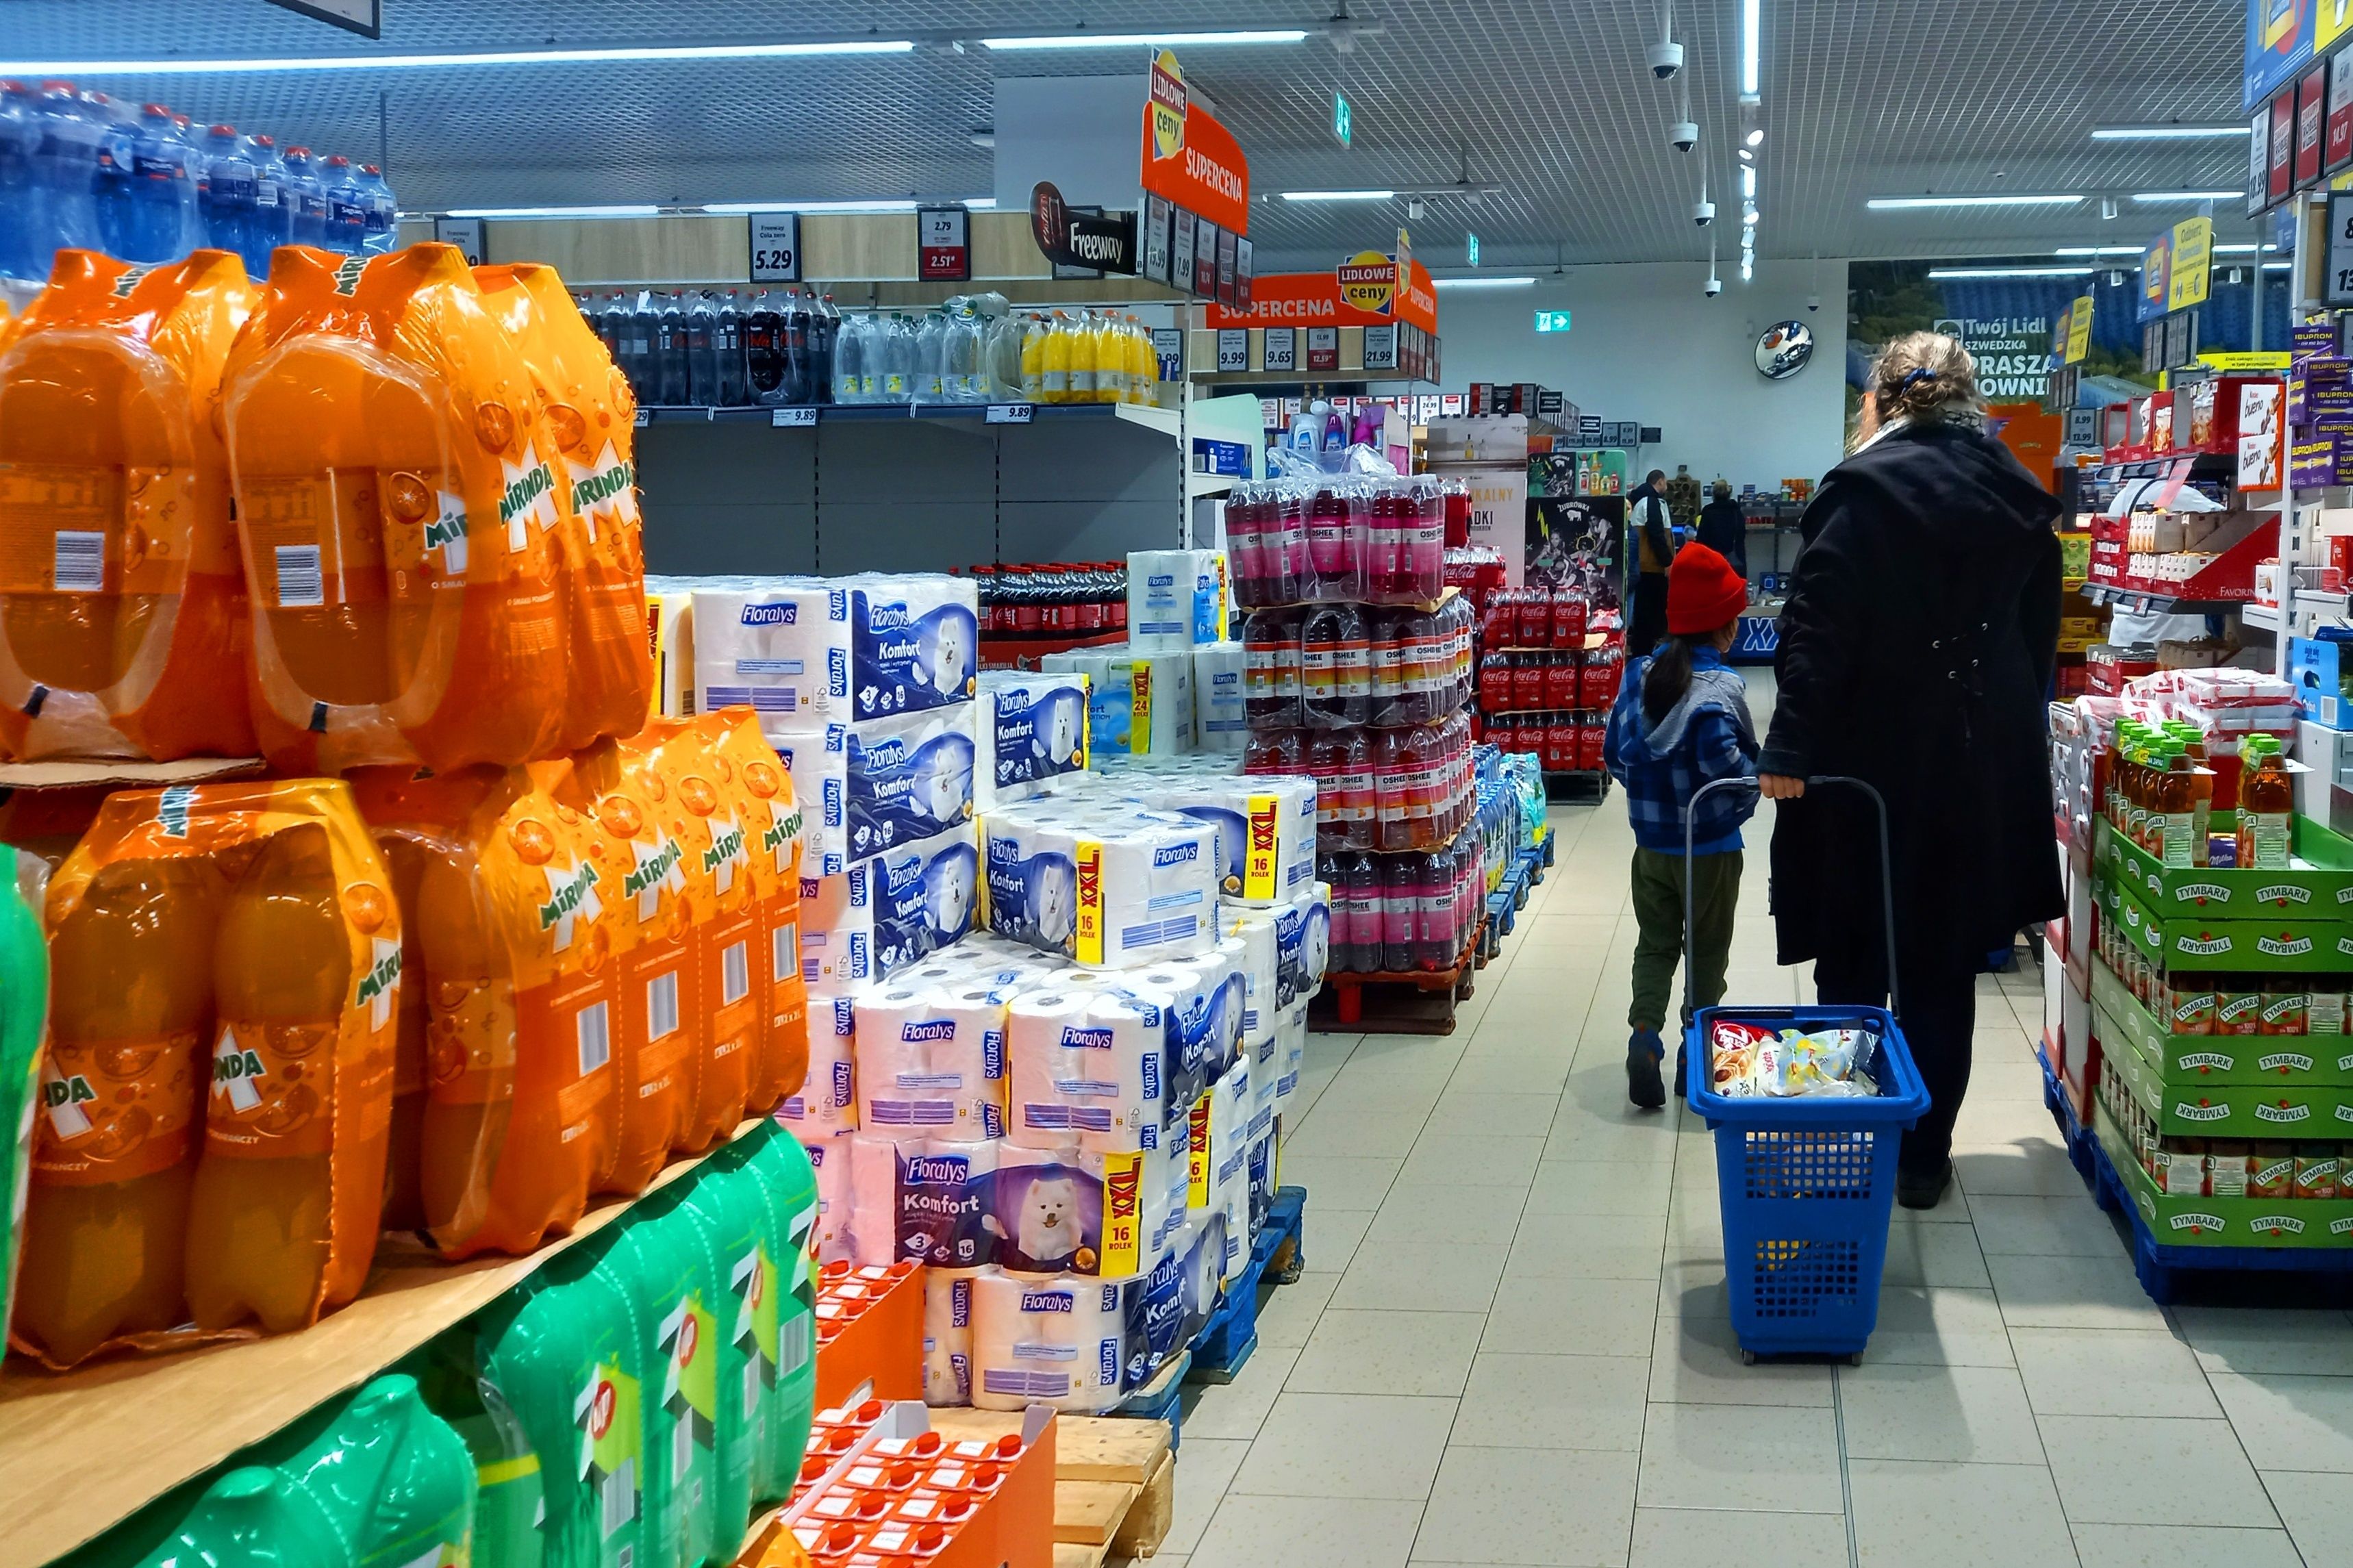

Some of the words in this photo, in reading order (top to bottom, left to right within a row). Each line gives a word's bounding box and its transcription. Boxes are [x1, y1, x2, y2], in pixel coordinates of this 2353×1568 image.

[1153, 71, 1186, 110] LIDLOWE
[1157, 112, 1179, 140] ceny
[1185, 147, 1242, 203] SUPERCENA
[935, 222, 951, 231] 2.79
[1070, 222, 1122, 264] Freeway
[755, 250, 792, 269] 5.29
[1342, 267, 1394, 281] LIDLOWE
[1350, 286, 1387, 301] ceny
[1966, 317, 2008, 338] Twój
[2013, 317, 2046, 334] Lidl
[1965, 340, 2027, 351] SZWEDZKA
[1220, 352, 1244, 364] 9.99
[1268, 351, 1292, 363] 9.65
[1366, 351, 1391, 362] 21.99
[794, 411, 815, 420] 9.89
[1009, 407, 1029, 417] 9.89
[2245, 399, 2263, 418] bueno
[2075, 416, 2090, 425] 8.99
[2243, 450, 2261, 471] bueno
[1149, 576, 1172, 586] Floralys
[1443, 565, 1476, 579] oca-Cola
[2220, 587, 2255, 596] FAVORIN
[744, 606, 795, 624] Floralys
[871, 604, 910, 628] Floralys
[879, 639, 920, 659] Komfort
[831, 650, 844, 695] Floralys
[1134, 666, 1150, 697] XXL
[1213, 674, 1237, 684] Floralys
[1000, 693, 1030, 713] Floralys
[1135, 700, 1147, 711] 24
[998, 723, 1033, 740] Komfort
[1582, 729, 1606, 742] Coca-Col
[868, 746, 905, 769] Floralys
[873, 774, 917, 798] Komfort
[826, 779, 840, 826] Floralys
[1251, 801, 1276, 851] XXL
[1156, 844, 1197, 864] Floralys
[1254, 858, 1268, 870] 16
[890, 863, 919, 890] Floralys
[1079, 850, 1100, 908] XXL
[2178, 886, 2227, 900] TYMBARK
[2258, 887, 2307, 900] TYMBARK
[896, 890, 928, 916] Komfort
[1081, 915, 1092, 930] 16
[1079, 931, 1096, 939] ROLEK
[2180, 939, 2230, 952] TYMBARK
[2261, 939, 2310, 953] TYMBARK
[853, 934, 865, 978] Floralys
[2178, 996, 2215, 1018] TYMBARK
[2222, 996, 2259, 1018] TYMBARK
[2265, 997, 2302, 1020] TYMBARK
[905, 1023, 953, 1040] Floralys
[1064, 1029, 1112, 1048] Floralys
[986, 1033, 1001, 1079] Floralys
[2182, 1055, 2229, 1068] TYMBARK
[2262, 1056, 2309, 1069] TYMBARK
[835, 1063, 850, 1107] Floralys
[1144, 1054, 1157, 1099] Floralys
[2180, 1106, 2227, 1118] TYMBARK
[2260, 1107, 2307, 1120] TYMBARK
[907, 1156, 968, 1185] Floralys
[2258, 1161, 2293, 1183] TYMBARK
[2300, 1161, 2337, 1183] TYMBARK
[1108, 1157, 1142, 1219] XXL
[904, 1193, 979, 1214] Komfort
[2174, 1215, 2222, 1229] TYMBARK
[2253, 1219, 2302, 1231] TYMBARK
[1112, 1226, 1130, 1241] 16
[916, 1237, 924, 1248] 3
[960, 1245, 972, 1254] 16
[1109, 1241, 1133, 1250] ROLEK
[953, 1280, 968, 1328] Floralys
[1022, 1293, 1072, 1313] Floralys
[1101, 1339, 1117, 1385] Floralys
